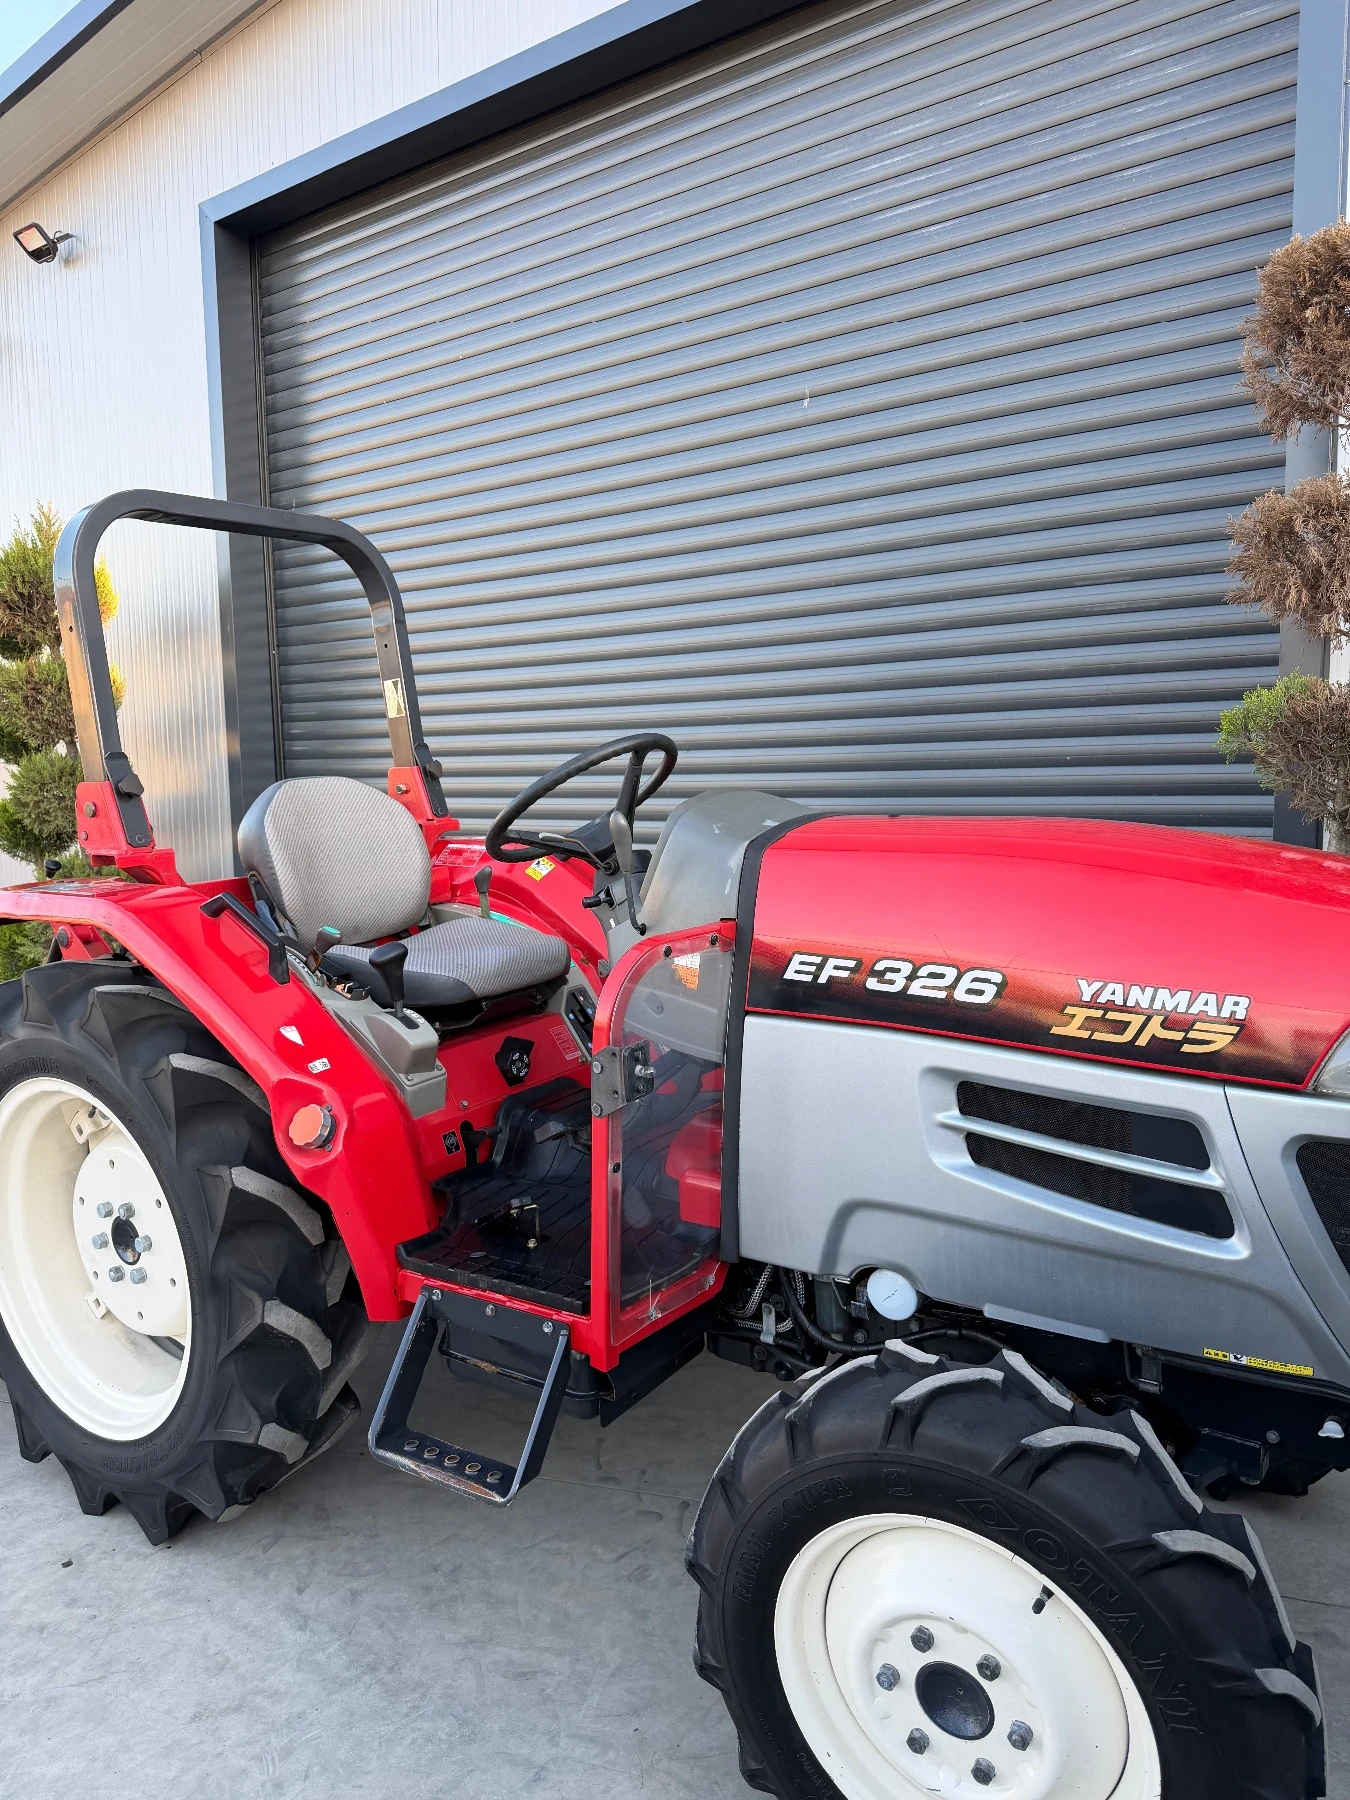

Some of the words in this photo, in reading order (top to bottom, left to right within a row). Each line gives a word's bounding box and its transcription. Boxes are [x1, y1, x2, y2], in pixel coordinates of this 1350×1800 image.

[782, 953, 858, 985] EF
[865, 959, 1004, 1005] 326
[1077, 978, 1250, 1020] YANMAR
[1050, 1005, 1241, 1054] エコトラ
[101, 1444, 169, 1474] TRACTOR
[767, 1475, 853, 1532] POWER
[1022, 1527, 1205, 1737] OTANI
